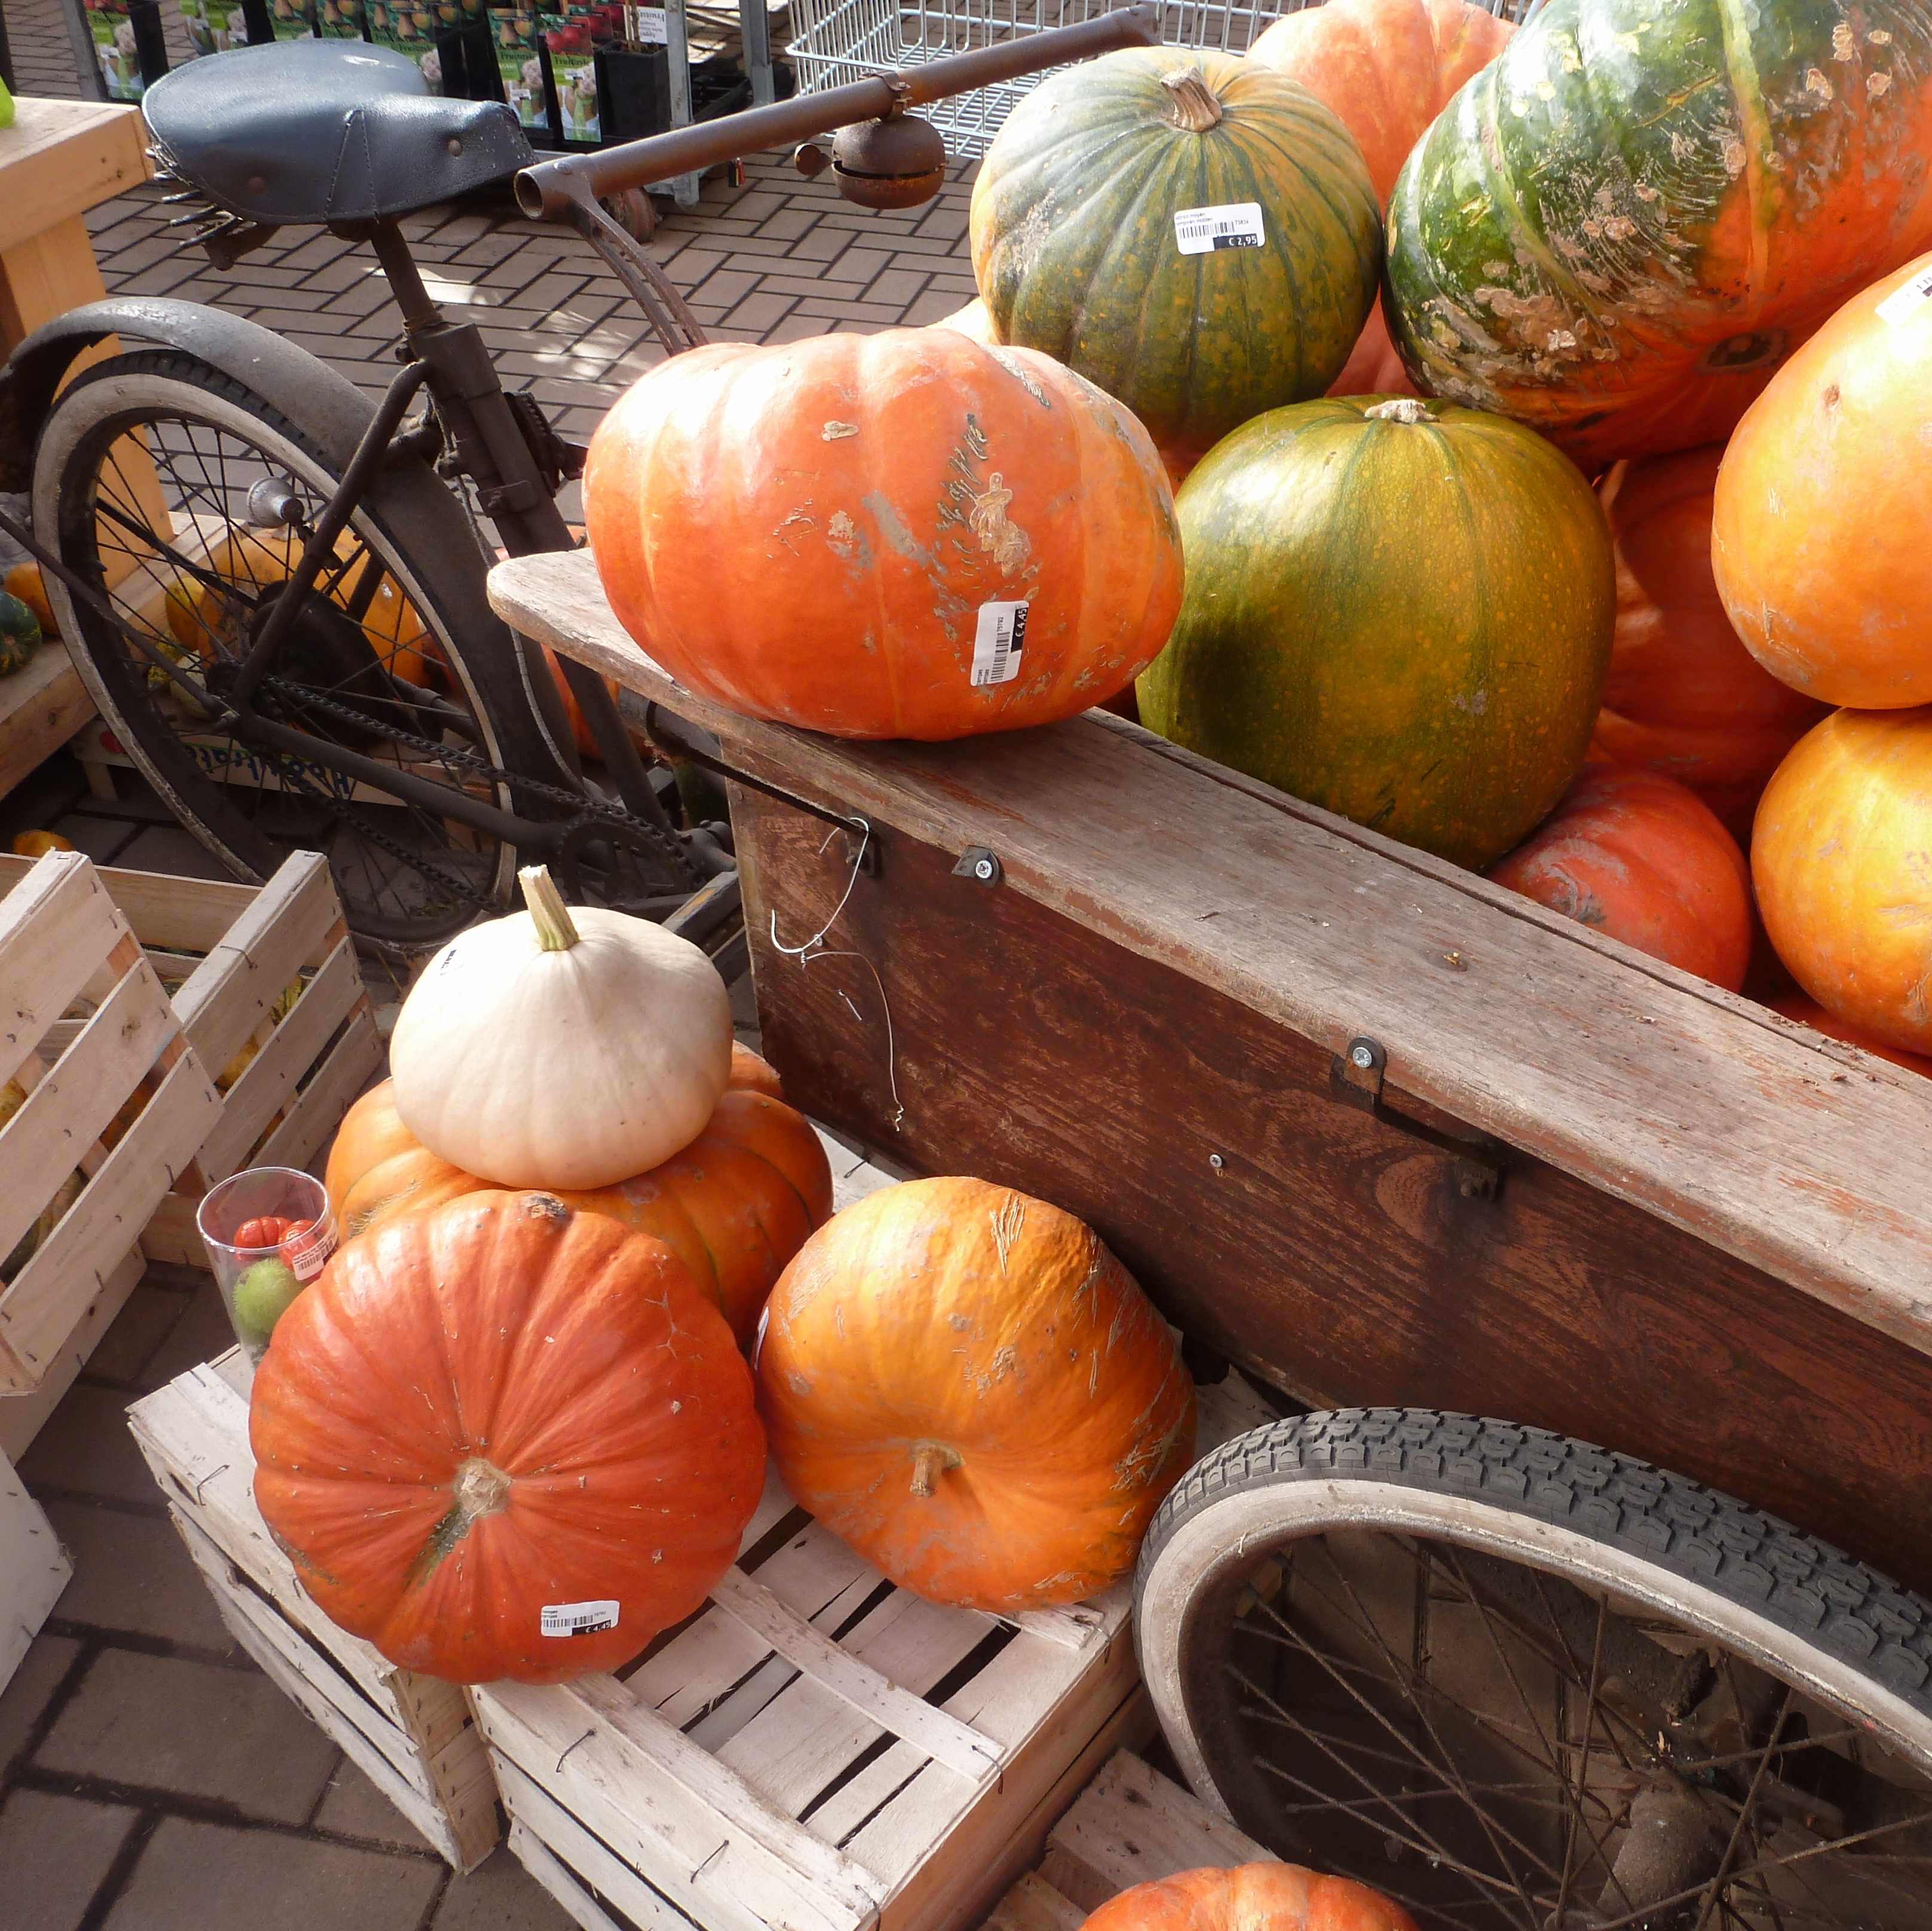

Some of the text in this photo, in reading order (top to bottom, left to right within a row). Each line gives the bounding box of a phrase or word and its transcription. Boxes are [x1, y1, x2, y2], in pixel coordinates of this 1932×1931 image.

[1237, 236, 1257, 247] 2,95
[1016, 609, 1027, 629] 4,45
[593, 1623, 611, 1631] 4,45
